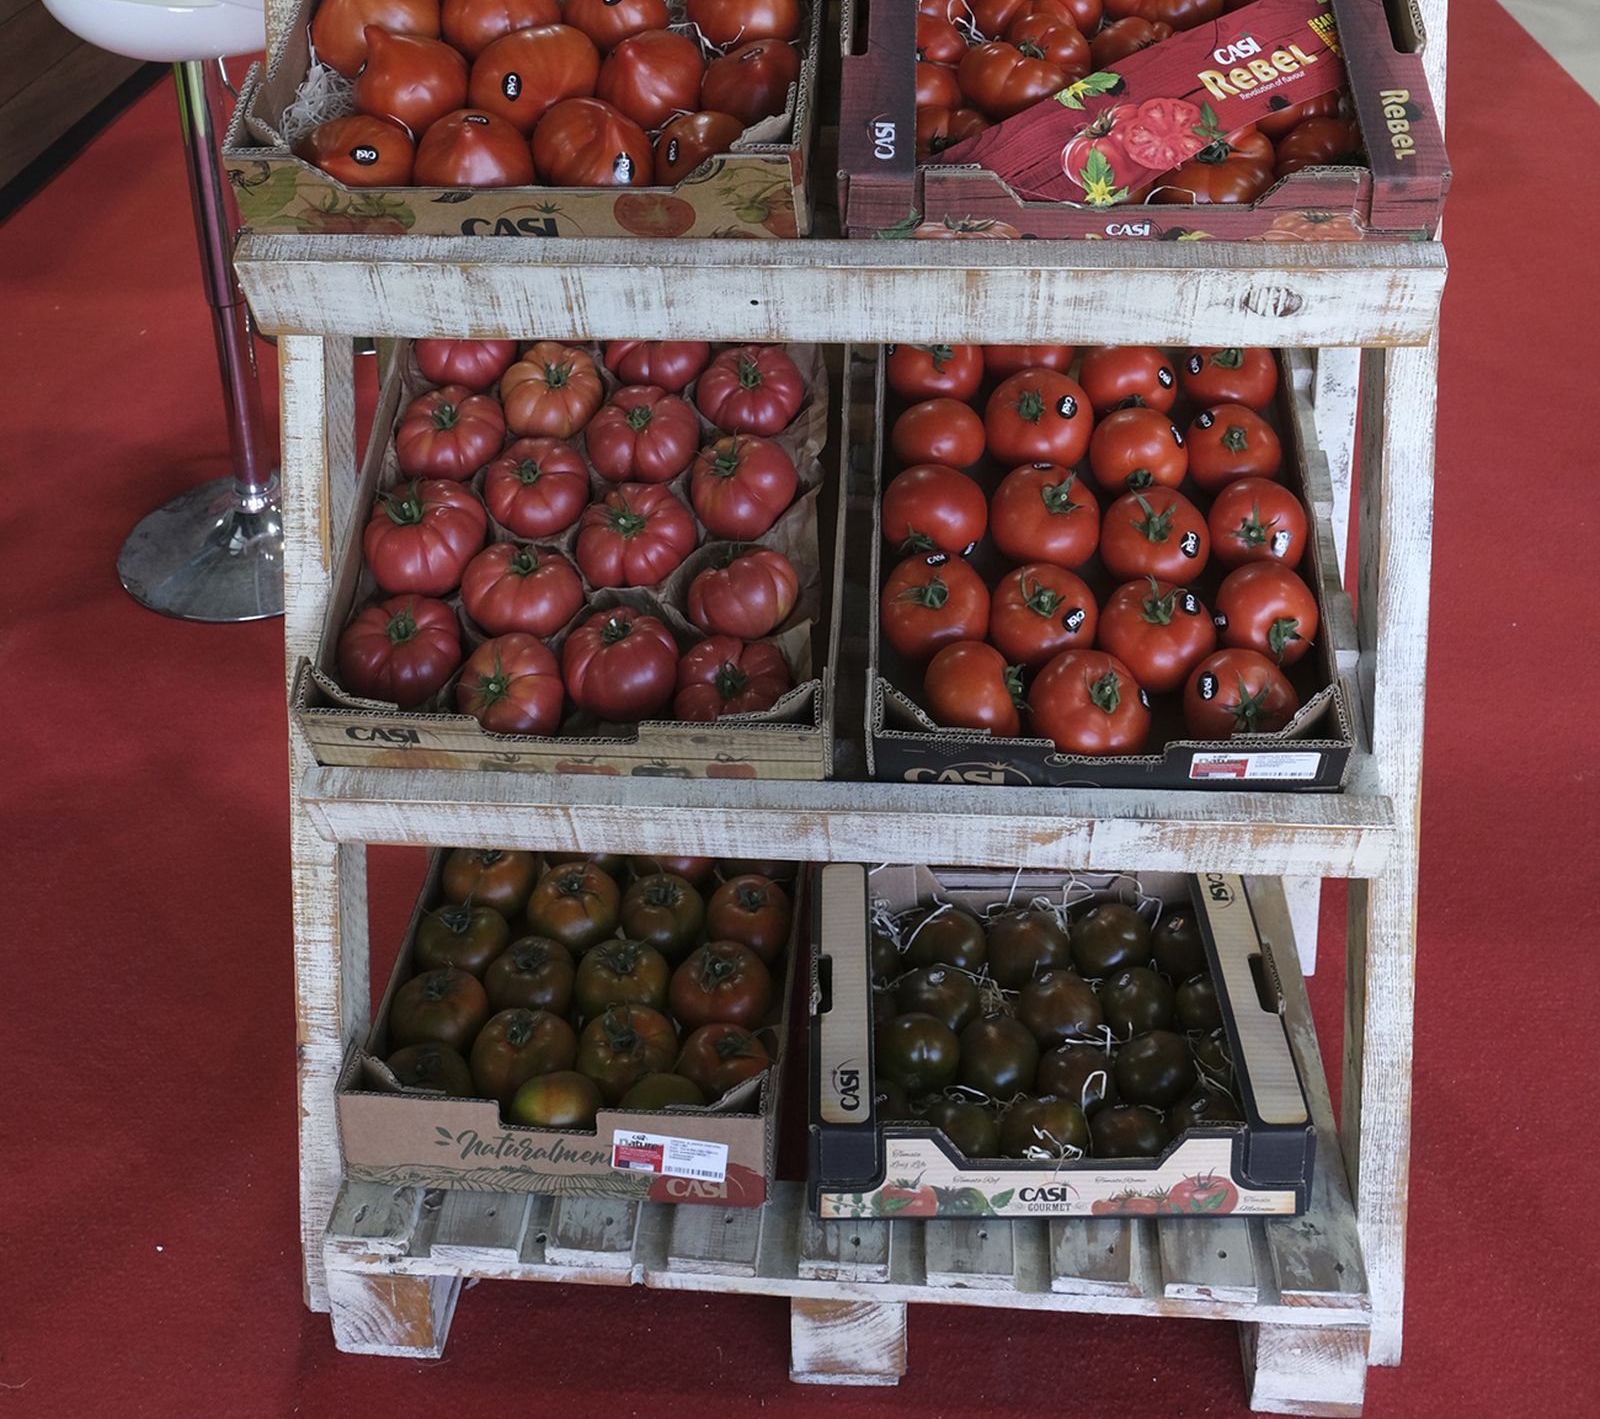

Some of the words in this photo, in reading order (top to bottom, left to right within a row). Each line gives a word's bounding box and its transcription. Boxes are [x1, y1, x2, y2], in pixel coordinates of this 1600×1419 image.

[1213, 35, 1262, 65] CASI
[506, 75, 517, 96] CASI
[1239, 81, 1275, 101] Revolution
[874, 122, 896, 160] CASI
[356, 149, 376, 160] CASI
[461, 217, 560, 237] CASI
[1106, 223, 1150, 237] CASI
[1061, 396, 1074, 414] CASI
[927, 554, 945, 565] CASI
[1186, 594, 1196, 612] CASI
[1067, 610, 1086, 627] CASI
[1203, 677, 1213, 699] CASI
[345, 726, 421, 744] CASI
[904, 768, 1005, 784] CASI
[1206, 873, 1229, 901] CASI
[840, 1069, 860, 1112] CASI
[666, 1177, 728, 1199] CASI
[1019, 1187, 1067, 1202] CASI
[1027, 1202, 1071, 1212] GOURMET
